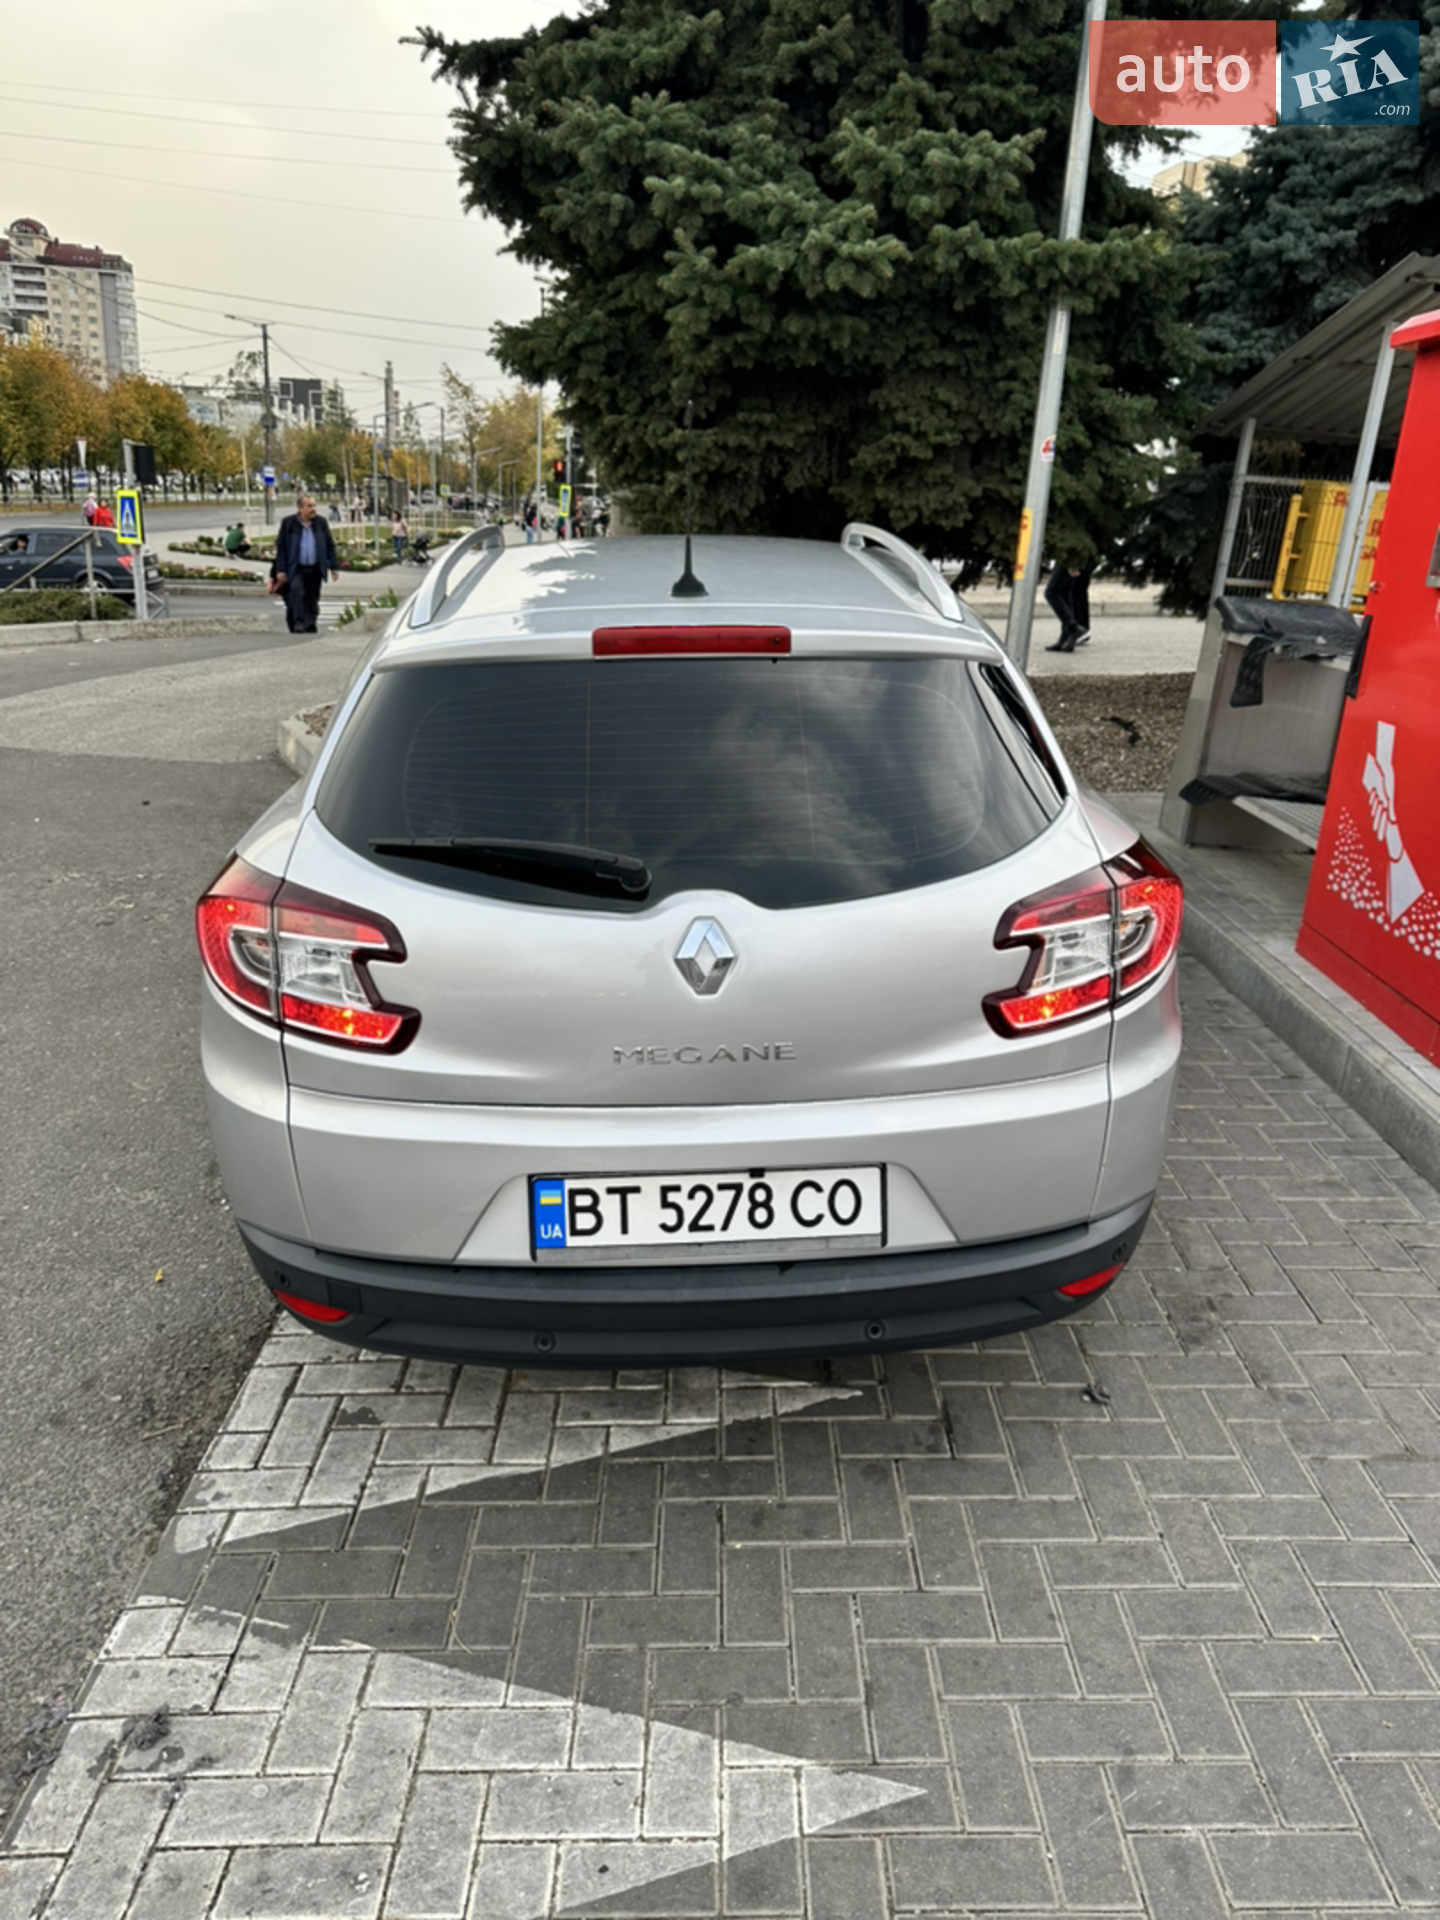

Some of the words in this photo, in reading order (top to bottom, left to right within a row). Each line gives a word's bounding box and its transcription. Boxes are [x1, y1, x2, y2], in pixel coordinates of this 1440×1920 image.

[612, 1041, 798, 1065] MEGANE
[567, 1185, 642, 1237] BT
[658, 1180, 775, 1234] 5278
[789, 1178, 863, 1228] CO
[540, 1223, 563, 1239] UA
